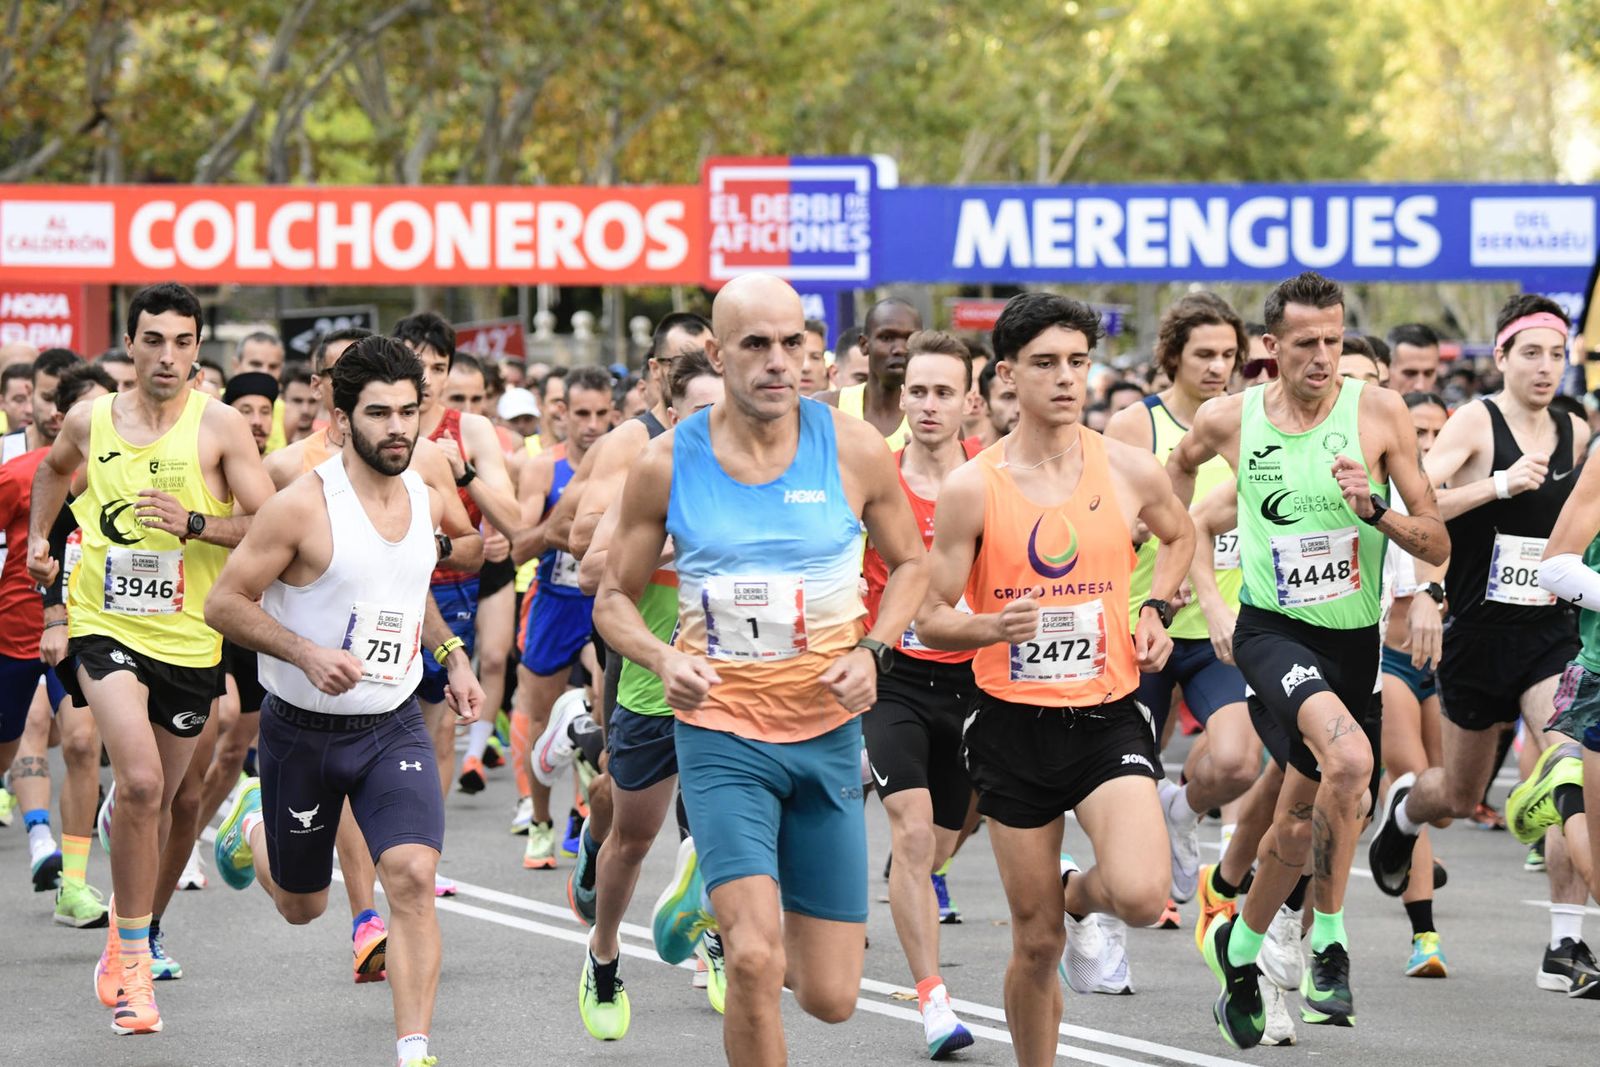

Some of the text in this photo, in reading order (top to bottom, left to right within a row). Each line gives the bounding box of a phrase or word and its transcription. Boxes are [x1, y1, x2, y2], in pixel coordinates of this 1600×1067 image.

[710, 193, 747, 224] EL
[751, 193, 842, 224] DERBI
[1514, 211, 1549, 229] DEL
[48, 216, 66, 229] AL
[953, 195, 1441, 270] MERENGUES
[7, 231, 106, 251] CALDERÓN
[130, 200, 689, 271] COLCHONEROS
[710, 222, 871, 253] AFICIONES
[784, 489, 827, 504] HOKA
[1294, 502, 1345, 513] MENORCA
[1287, 559, 1351, 588] 4448
[115, 576, 174, 599] 3946
[1052, 581, 1113, 597] HAFESA
[746, 617, 759, 639] 1
[365, 638, 402, 664] 751
[1026, 638, 1091, 664] 2472
